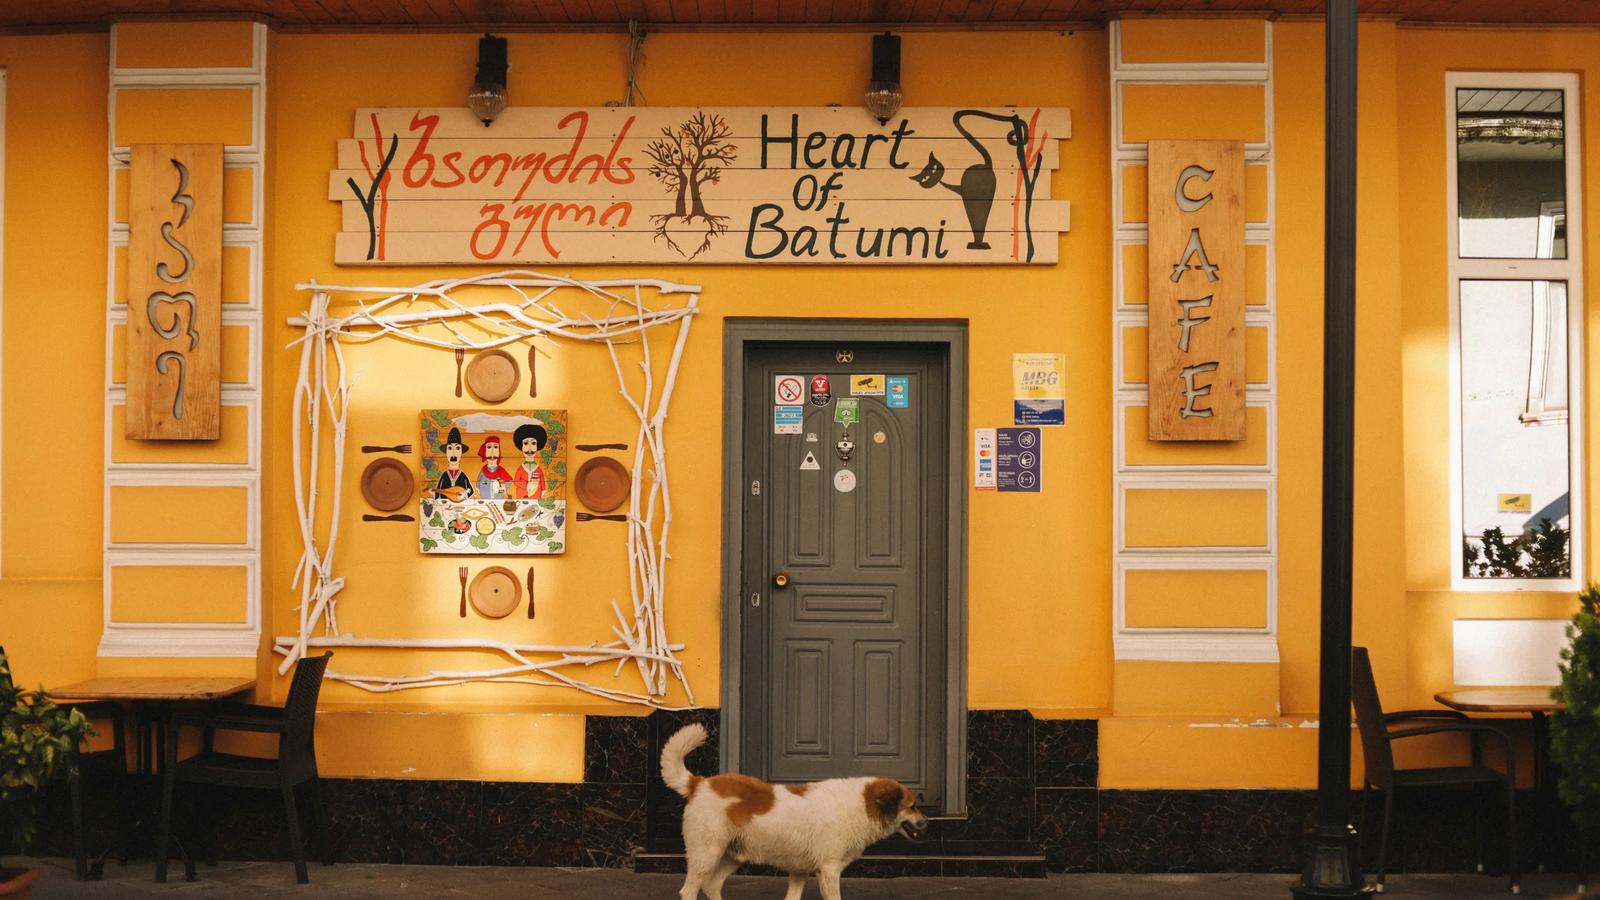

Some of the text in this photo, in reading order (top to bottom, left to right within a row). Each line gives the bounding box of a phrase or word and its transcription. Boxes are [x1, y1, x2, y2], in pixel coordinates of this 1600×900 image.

[402, 110, 636, 204] ბათუმის
[760, 113, 916, 170] Heart
[792, 171, 844, 212] Of
[469, 201, 633, 261] გული
[745, 202, 949, 259] Batumi
[147, 158, 200, 421] კაფე
[1169, 164, 1220, 420] CAFE
[1022, 371, 1058, 385] MBG
